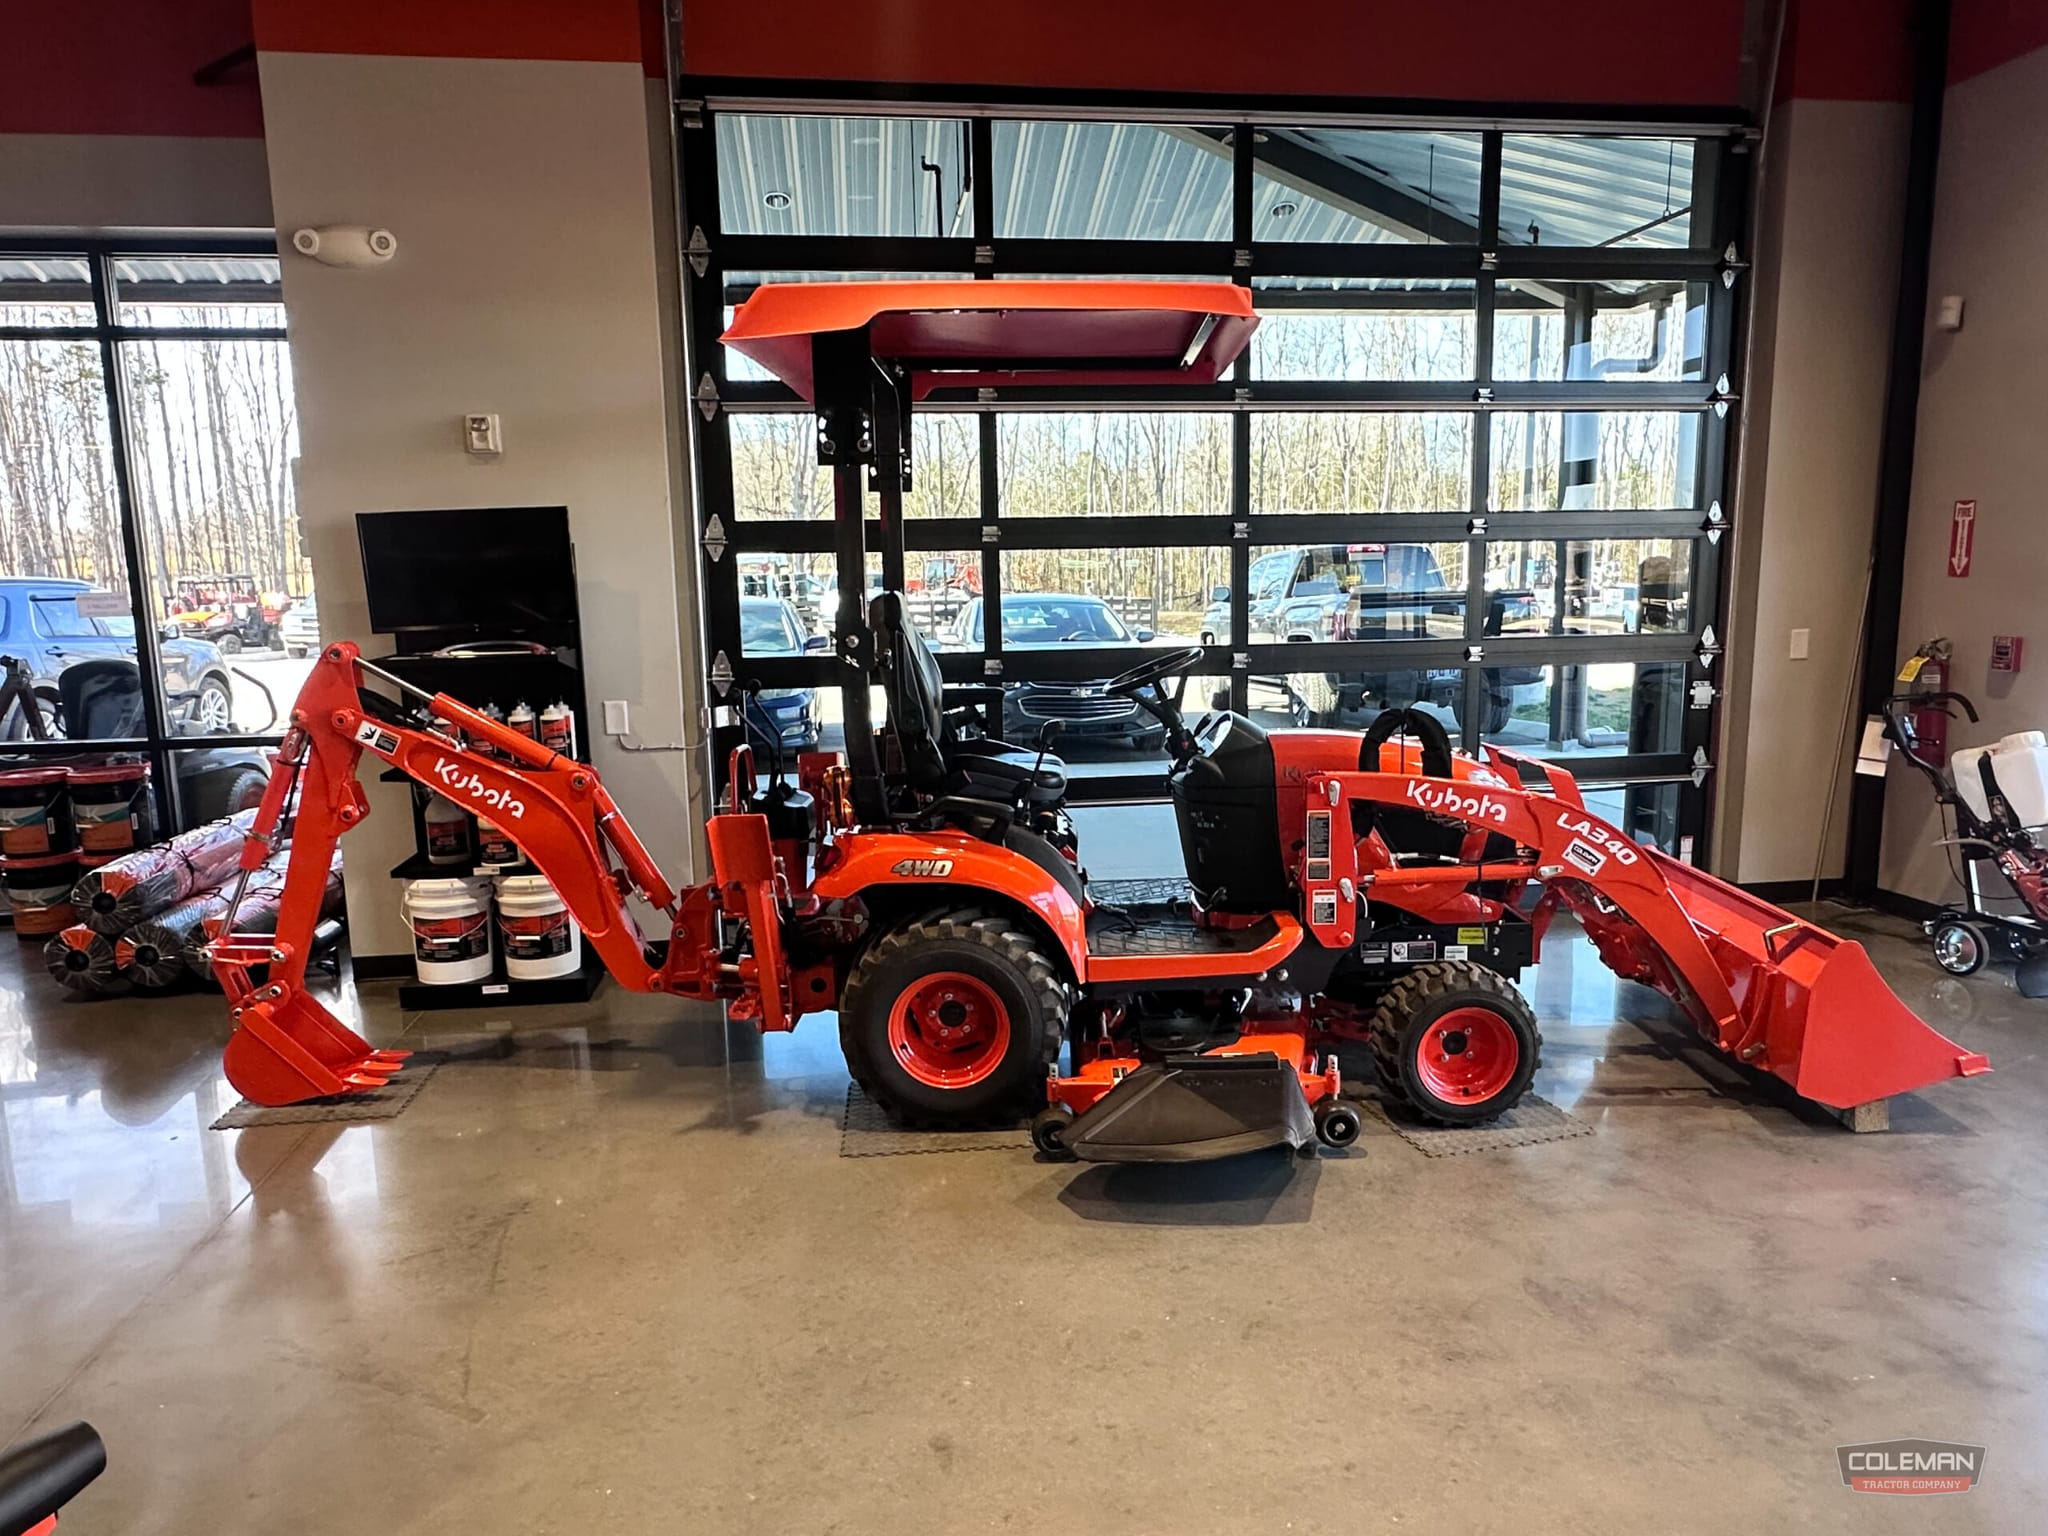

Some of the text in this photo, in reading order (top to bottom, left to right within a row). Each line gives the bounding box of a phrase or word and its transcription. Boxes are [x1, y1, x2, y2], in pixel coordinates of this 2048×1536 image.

[433, 757, 526, 819] Kubota
[1406, 780, 1507, 822] Kubota
[1556, 812, 1638, 865] LA340
[891, 859, 954, 877] 4WD
